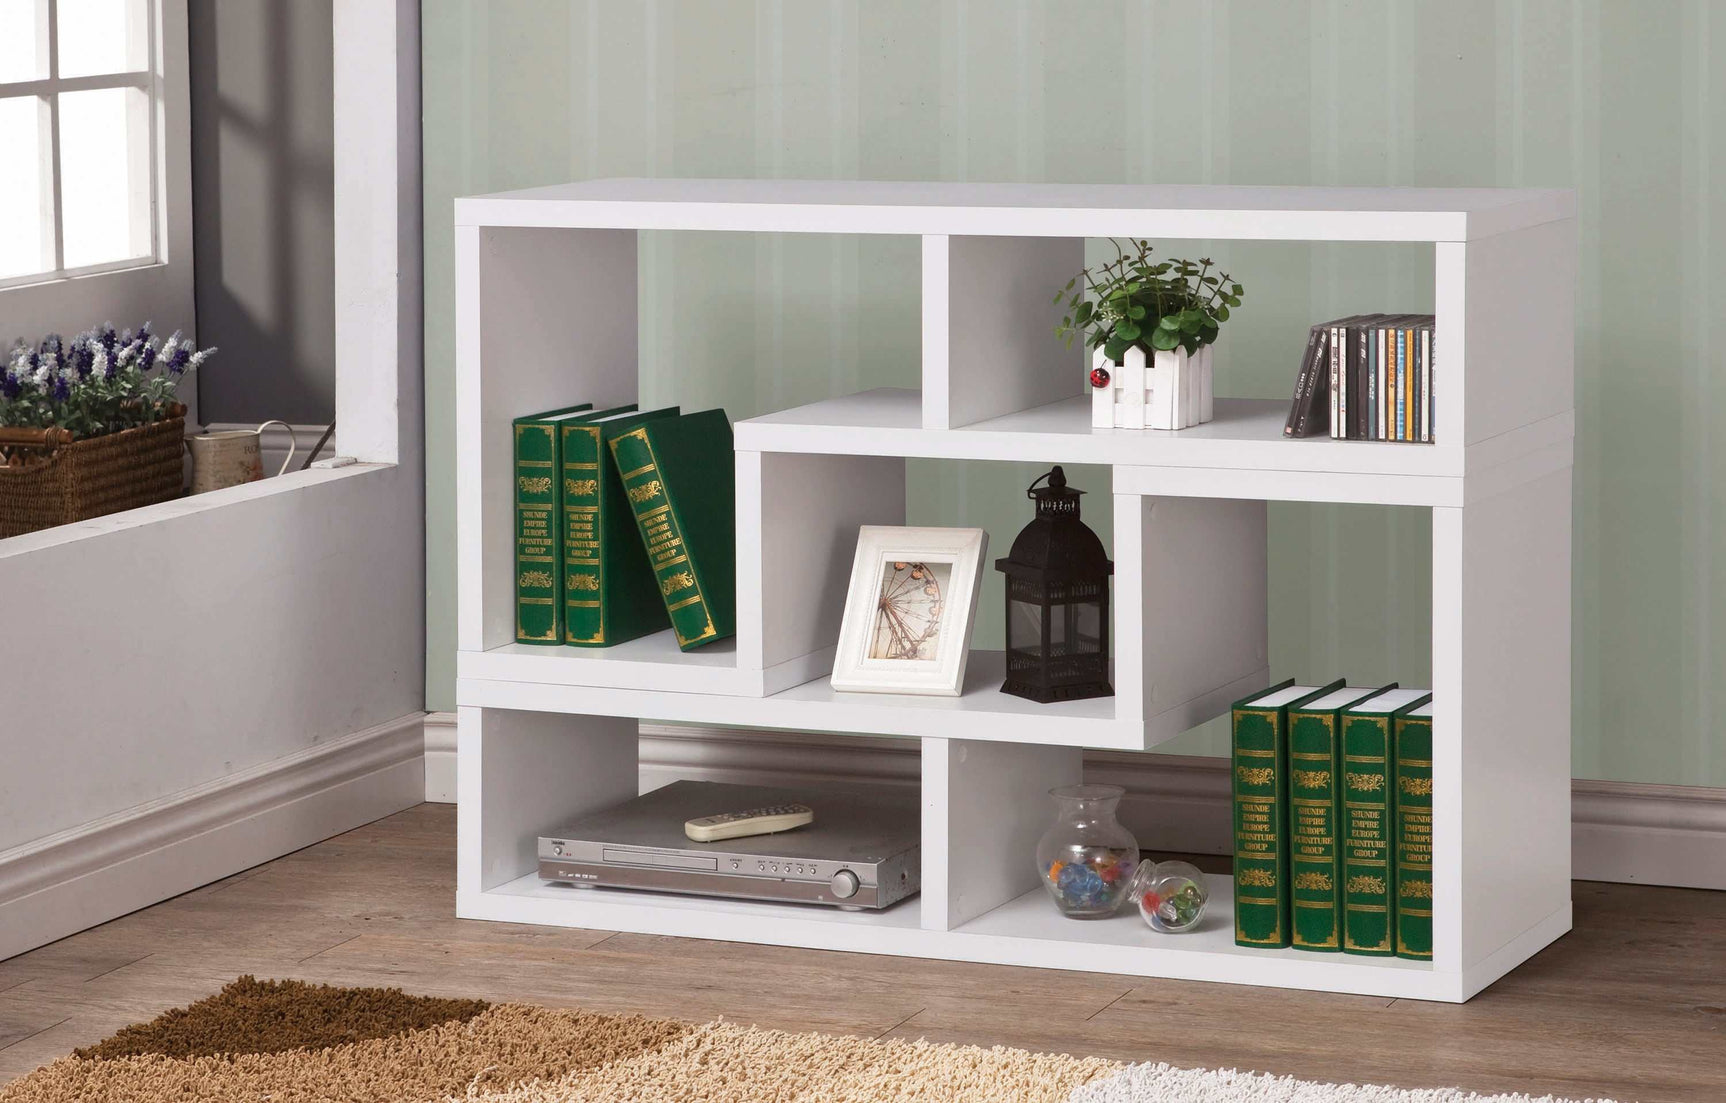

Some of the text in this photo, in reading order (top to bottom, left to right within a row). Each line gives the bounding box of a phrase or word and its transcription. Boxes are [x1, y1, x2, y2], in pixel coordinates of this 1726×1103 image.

[650, 531, 673, 544] EUROPE
[650, 538, 681, 555] FURNITURE
[1242, 804, 1270, 812] SHUNDE
[1243, 823, 1270, 831] EUROPE
[1352, 820, 1379, 828] EMPIRE
[1299, 826, 1326, 834] EUROPE
[1352, 830, 1380, 838] EUROPE
[1238, 832, 1276, 841] FURNITURE
[1294, 835, 1332, 844] FURNITURE
[1245, 842, 1268, 851] GROUP
[1347, 839, 1386, 847] FURNITURE
